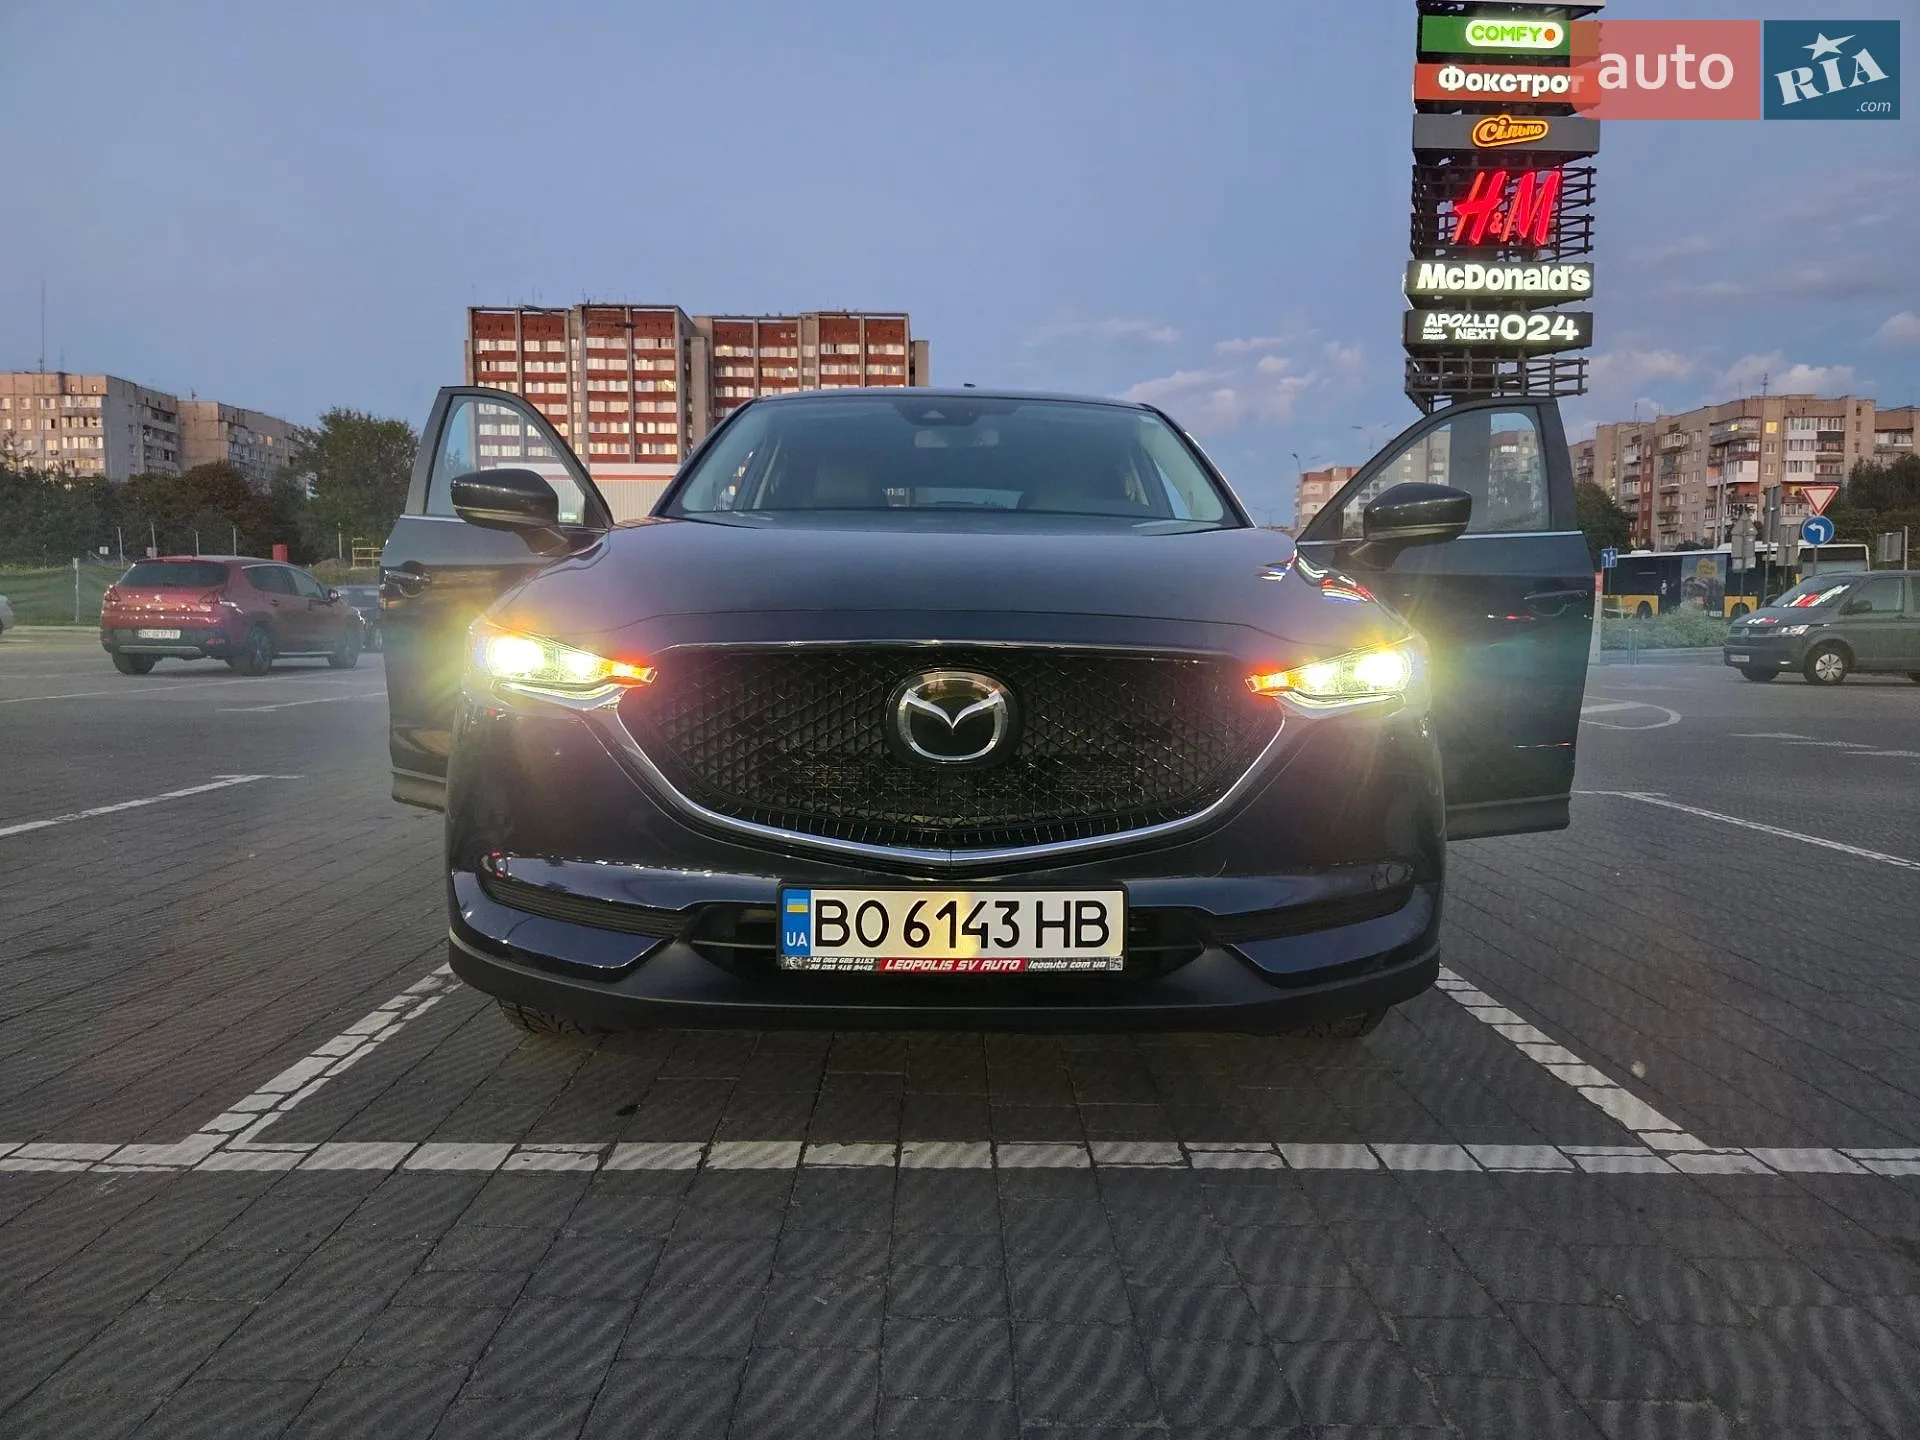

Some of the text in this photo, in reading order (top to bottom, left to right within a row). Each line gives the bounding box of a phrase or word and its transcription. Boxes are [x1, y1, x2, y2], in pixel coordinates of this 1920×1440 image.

[1471, 25, 1542, 42] COMFY
[1438, 65, 1584, 97] Фокстрот
[1453, 170, 1561, 246] H&M
[1416, 263, 1591, 291] McDonald's
[1424, 313, 1500, 328] APOLLO
[1455, 328, 1499, 340] NEXT
[903, 900, 1020, 949] 6143
[786, 931, 808, 947] UA
[885, 959, 1021, 971] LEOPOLIS SV AUTO
